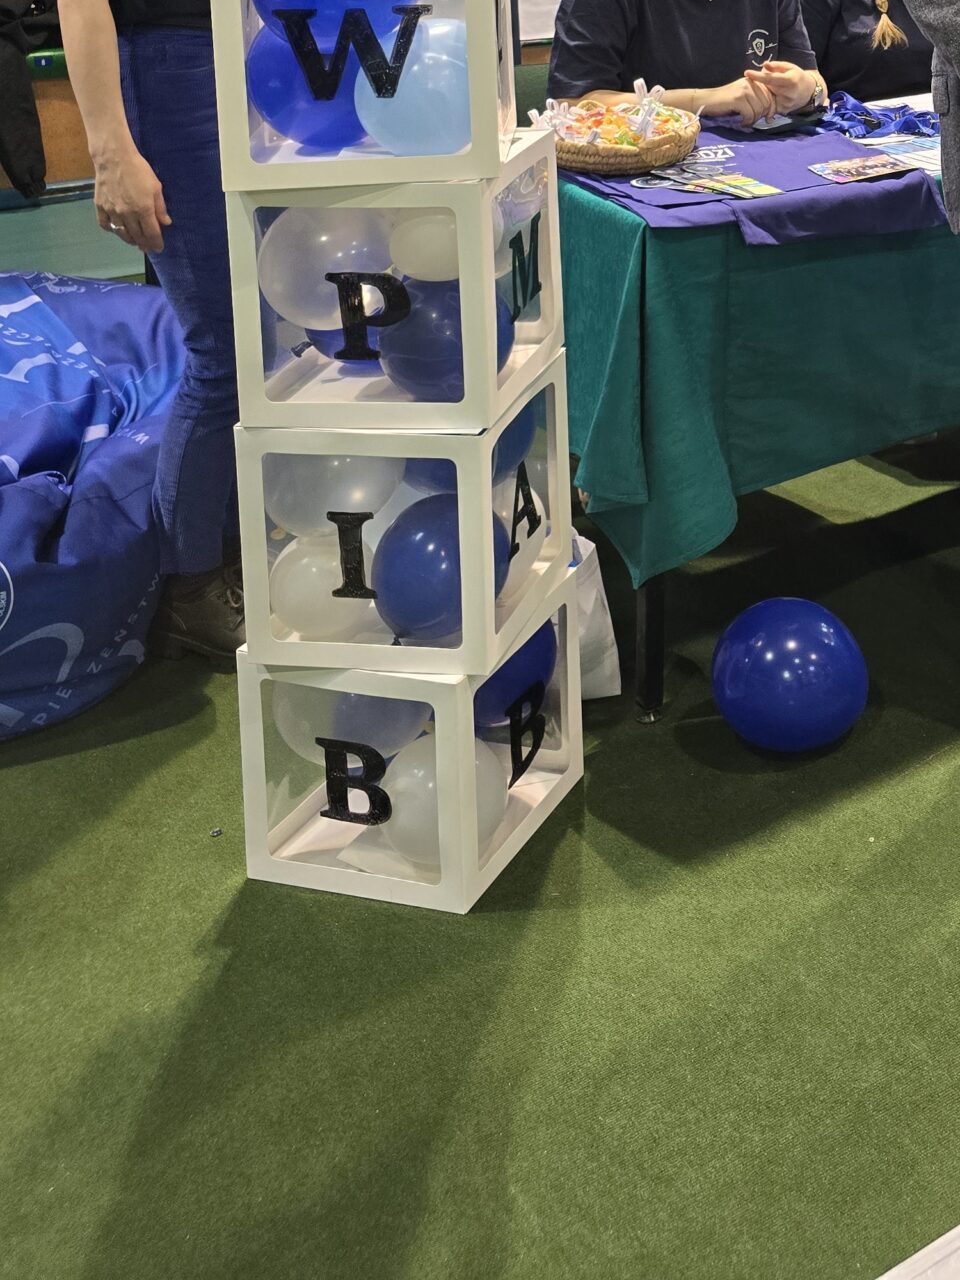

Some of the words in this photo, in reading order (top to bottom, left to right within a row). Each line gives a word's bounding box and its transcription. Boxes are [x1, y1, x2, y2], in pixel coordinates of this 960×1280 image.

[272, 3, 434, 102] W
[324, 271, 411, 362] P
[326, 511, 378, 600] I
[315, 736, 394, 826] B
